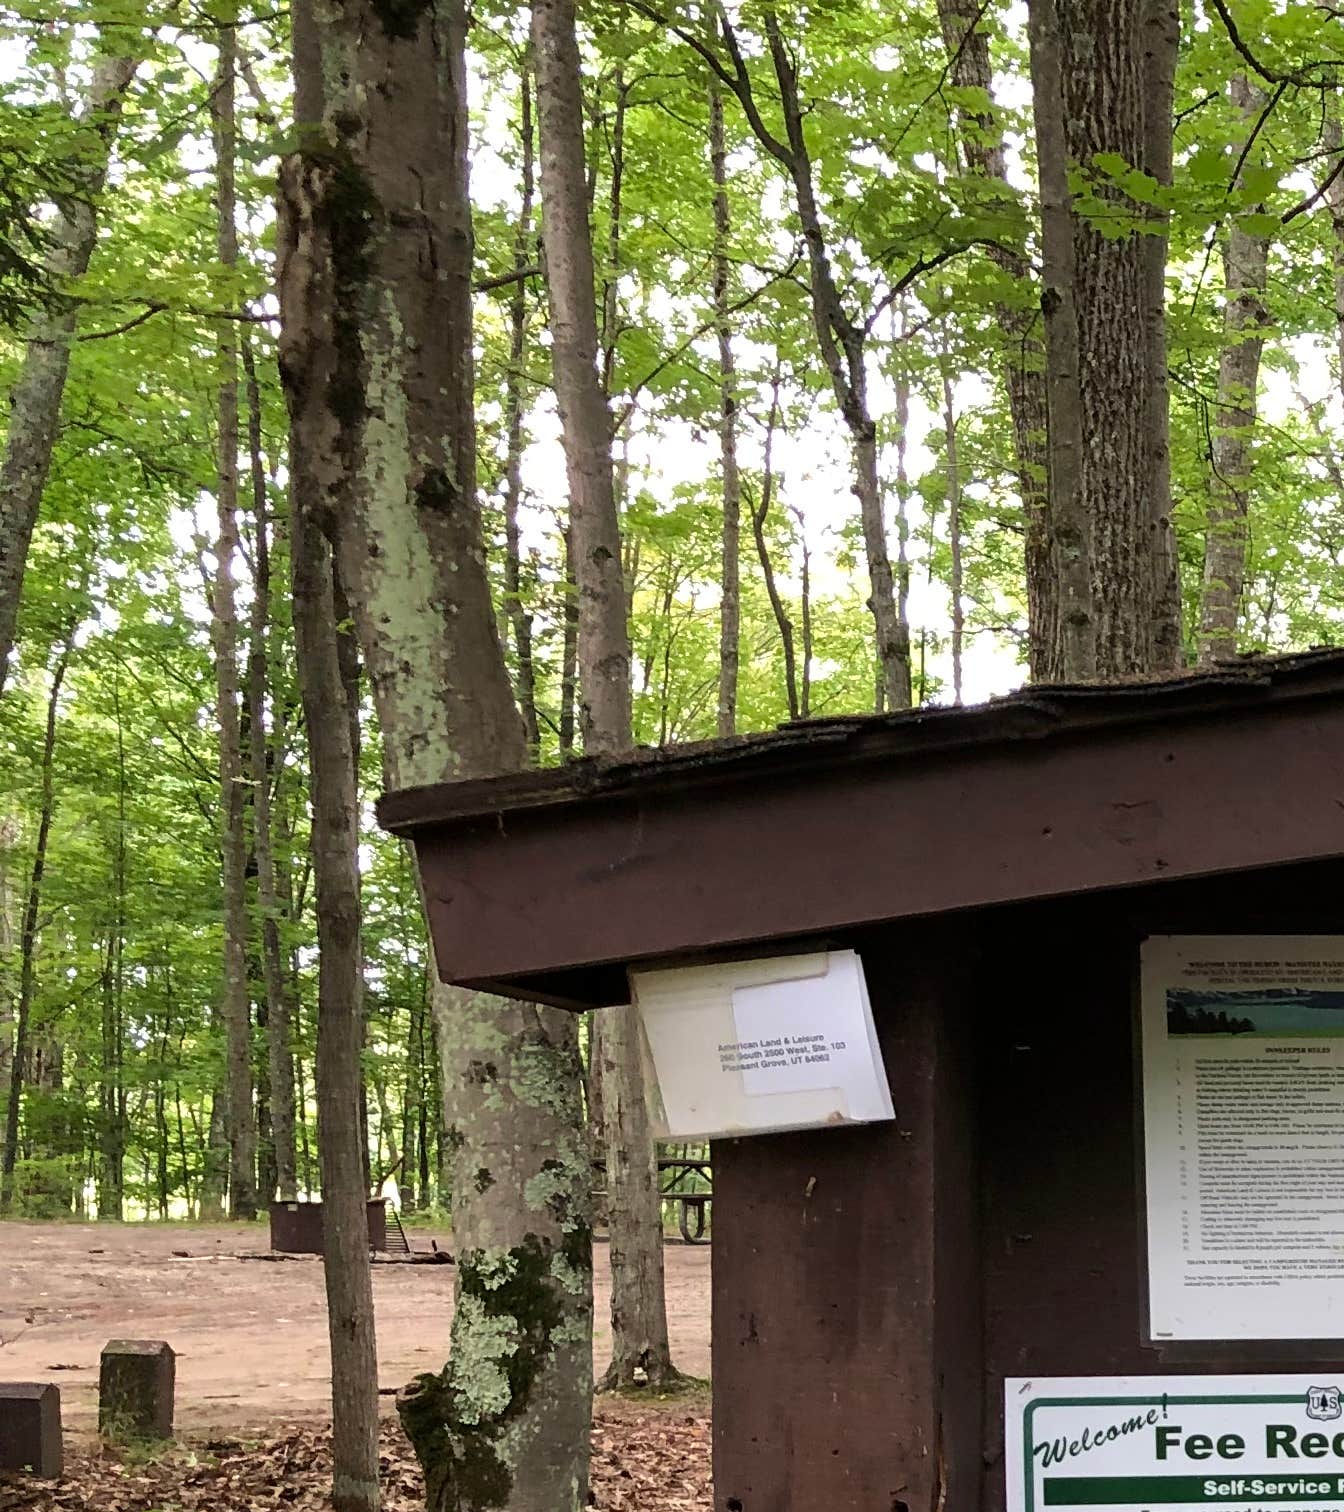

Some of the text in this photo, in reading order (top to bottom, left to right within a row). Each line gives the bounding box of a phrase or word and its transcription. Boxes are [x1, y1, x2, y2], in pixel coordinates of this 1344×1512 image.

[718, 1042, 758, 1052] American
[760, 1038, 781, 1047] Land
[792, 1035, 824, 1043] Leisure
[1034, 1392, 1169, 1468] Welcome!
[1155, 1426, 1245, 1460] Fee
[1204, 1479, 1330, 1496] Self-Service
